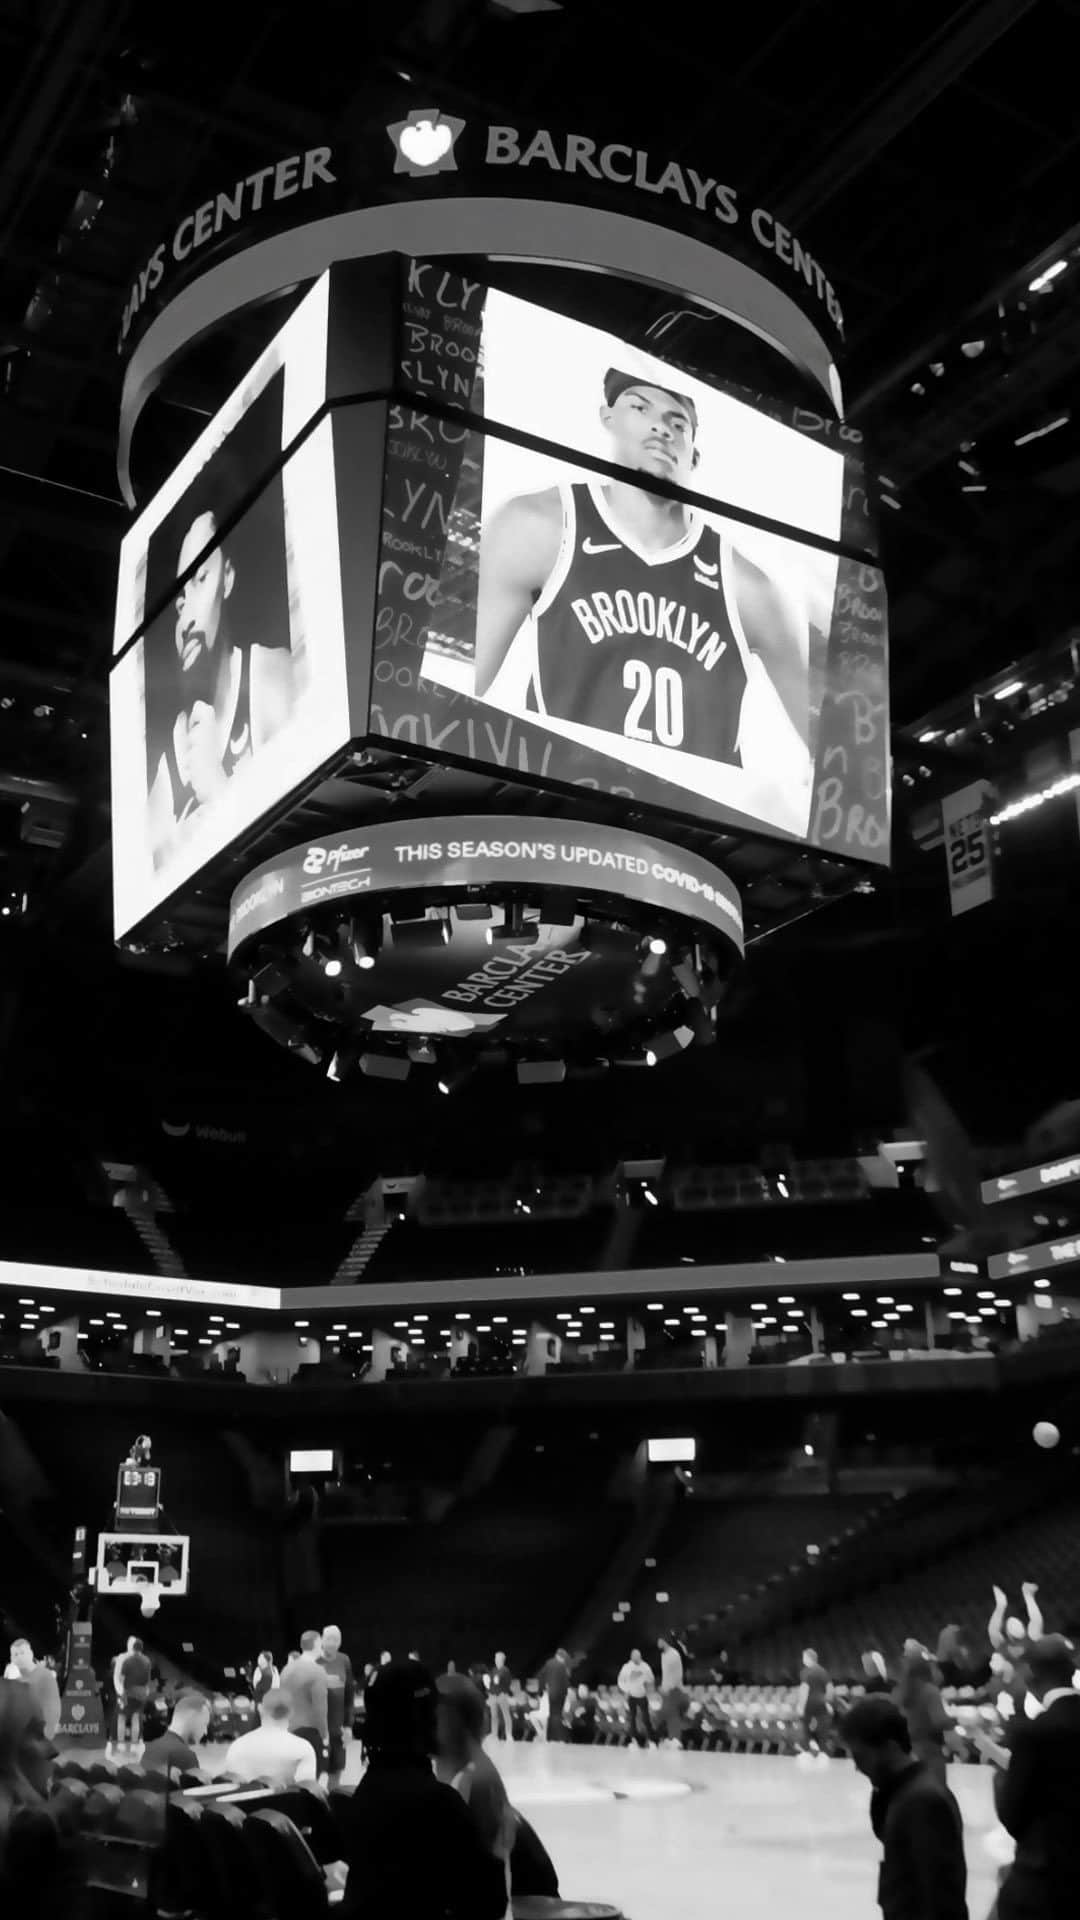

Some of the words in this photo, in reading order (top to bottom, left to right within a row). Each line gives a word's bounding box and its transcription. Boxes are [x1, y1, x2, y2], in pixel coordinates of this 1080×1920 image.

[173, 146, 337, 261] CENTER
[485, 126, 739, 224] BARCLAYS
[571, 589, 728, 672] BROOKLYN
[622, 659, 685, 748] 20
[395, 842, 443, 863] THIS
[447, 840, 556, 860] SEASON'S
[560, 844, 649, 875] UPDATED
[951, 829, 985, 875] 25
[483, 949, 592, 1008] CENTER
